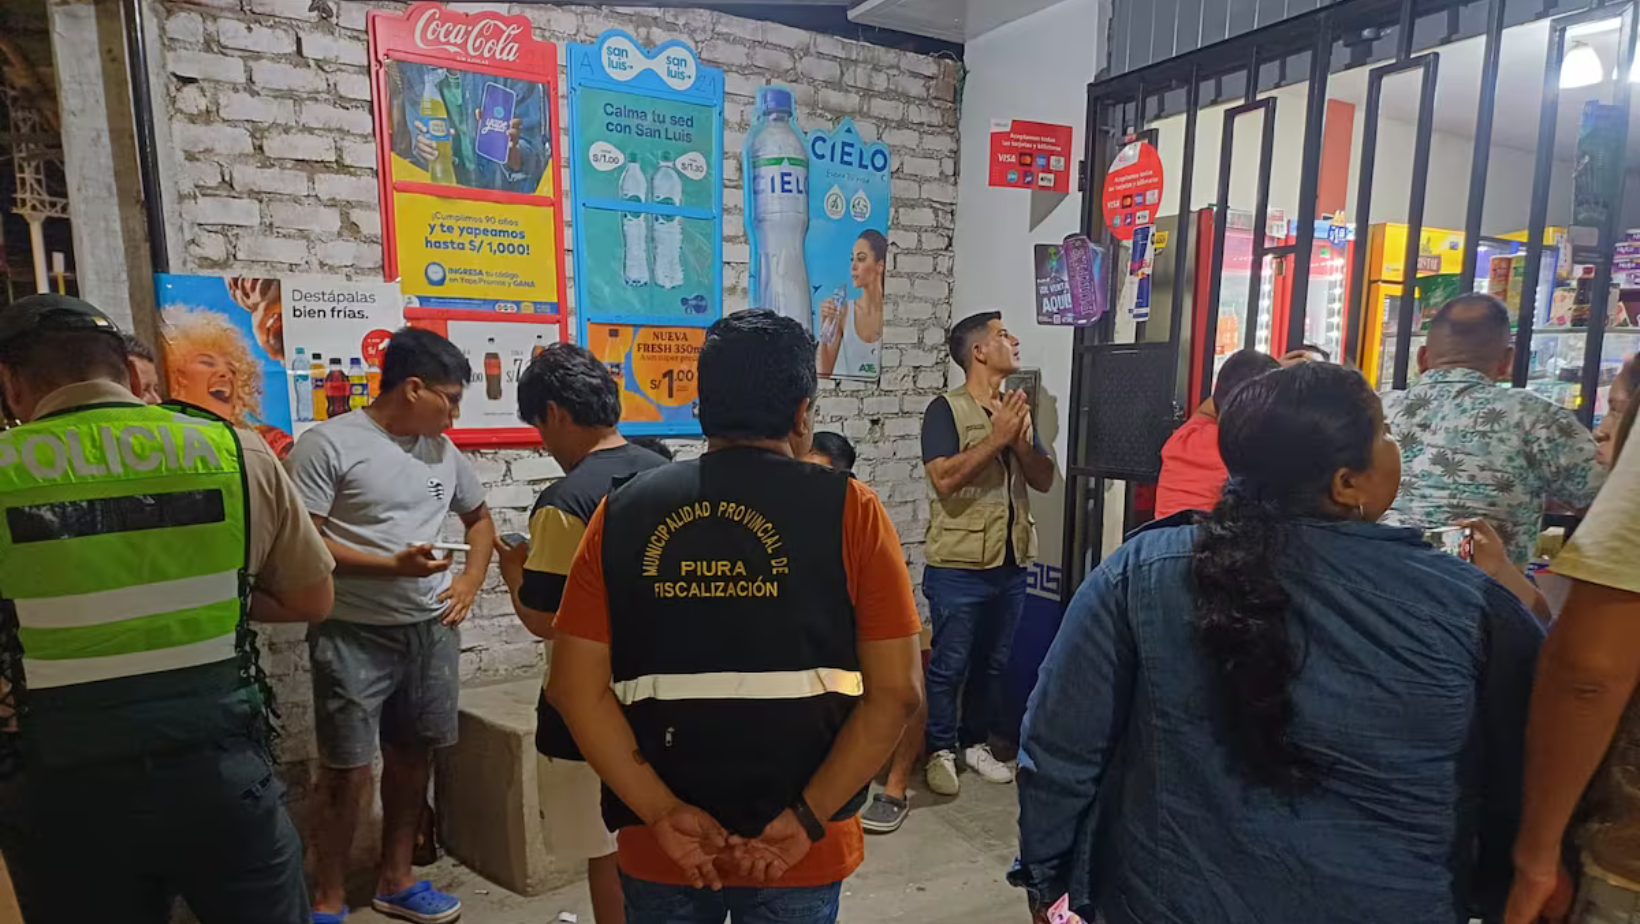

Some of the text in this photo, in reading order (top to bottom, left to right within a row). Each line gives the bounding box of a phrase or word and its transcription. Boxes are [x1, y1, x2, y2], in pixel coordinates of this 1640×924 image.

[414, 9, 522, 62] Coca-Cola
[606, 46, 629, 59] san
[607, 57, 627, 72] luis
[666, 55, 687, 69] san
[666, 66, 686, 80] luis
[603, 102, 694, 129] Calma tu sed
[606, 121, 693, 143] con San Luis
[811, 135, 888, 173] CIELO
[998, 153, 1016, 162] VISA
[1107, 200, 1120, 209] VISA
[484, 216, 497, 225] 90
[497, 217, 519, 227] años
[428, 222, 526, 240] y te yapeamos
[425, 236, 531, 256] hasta S/ 1,000!
[447, 267, 484, 277] INGRESA
[291, 289, 377, 305] Destápalas
[292, 305, 369, 320] bien frías.
[652, 331, 688, 342] NUEVA
[637, 343, 704, 355] FRESH 350m
[642, 501, 789, 577] MUNICIPALIDAD PROVINCIAL DE
[680, 560, 747, 576] PIURA
[654, 576, 778, 598] FISCALIZACIÓN
